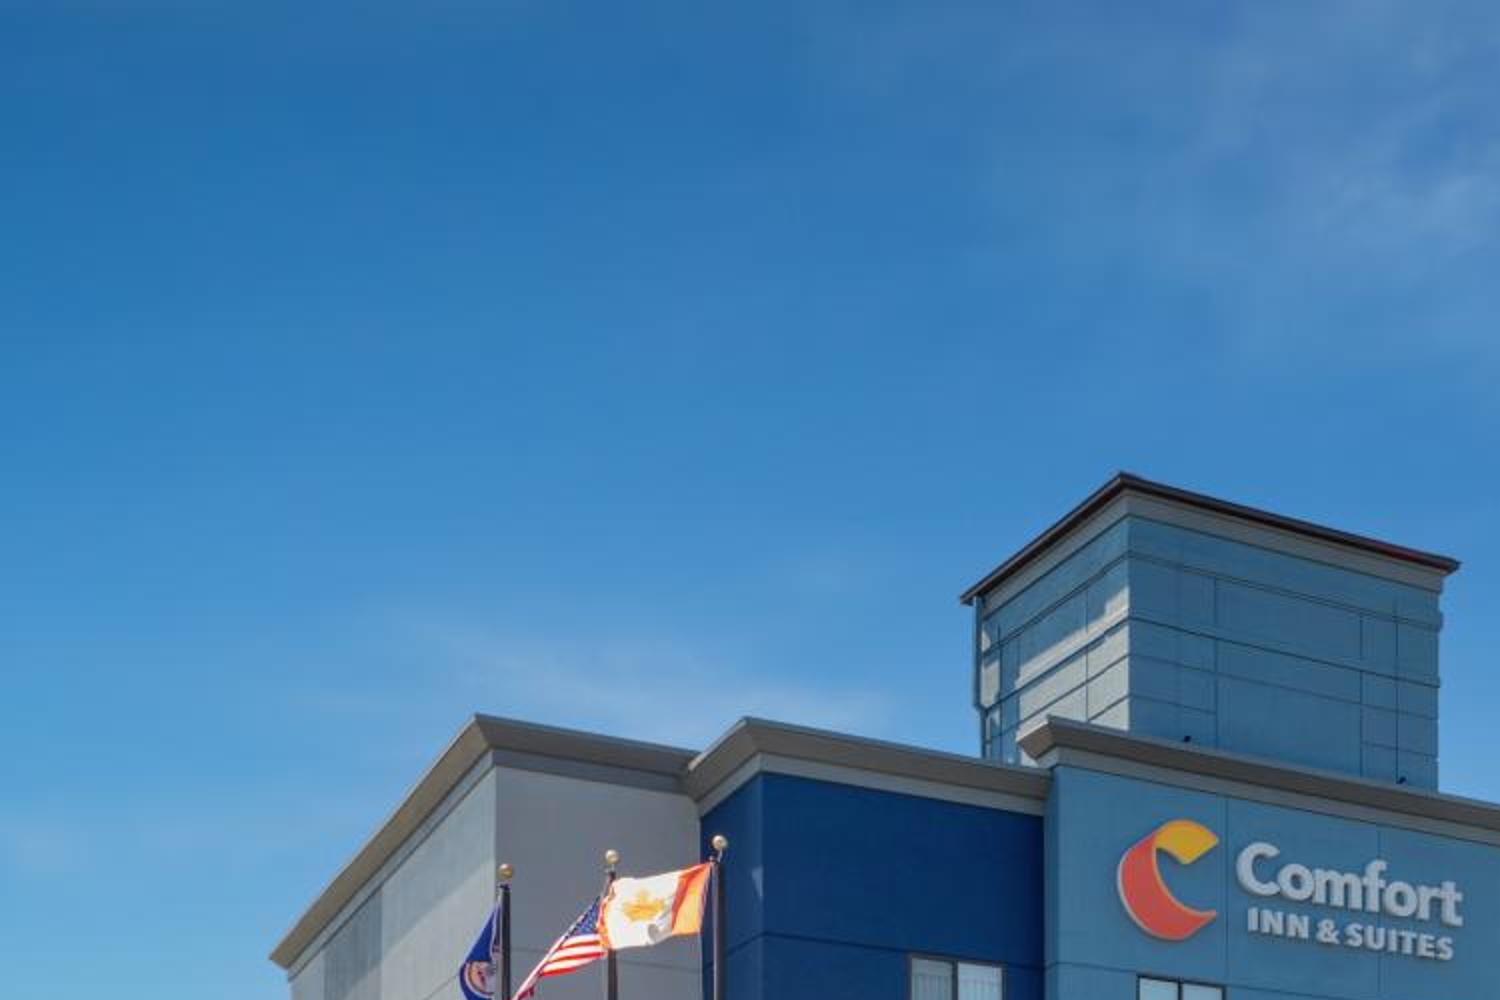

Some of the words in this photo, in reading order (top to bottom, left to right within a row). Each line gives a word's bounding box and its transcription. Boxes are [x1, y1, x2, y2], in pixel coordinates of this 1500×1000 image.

[1236, 842, 1463, 927] Comfort
[1248, 907, 1310, 939] INN
[1316, 919, 1340, 945] &
[1345, 923, 1454, 961] SUITES
